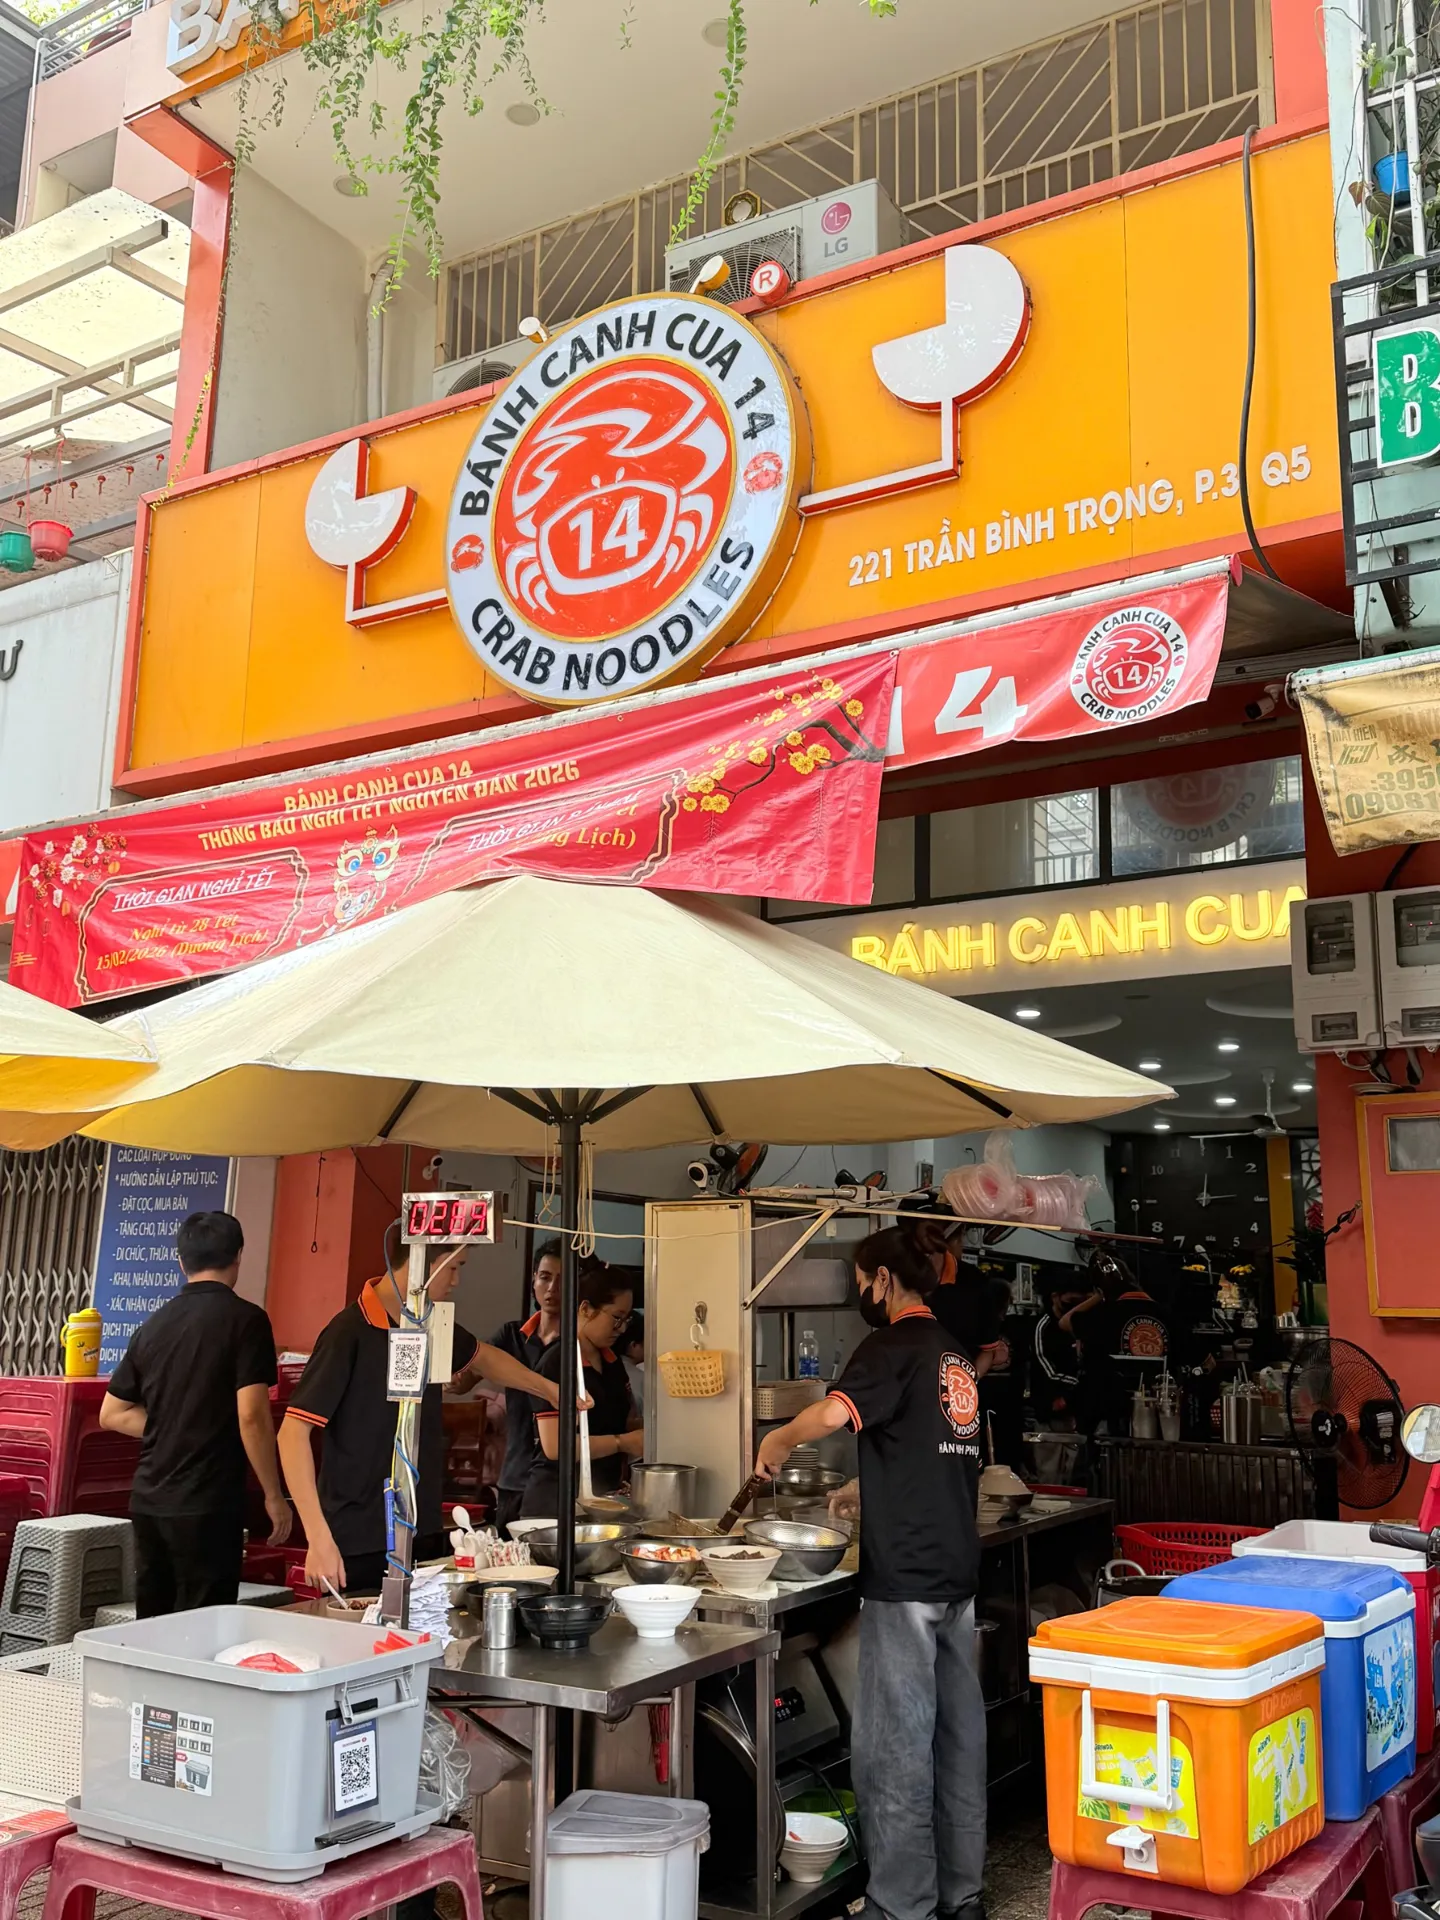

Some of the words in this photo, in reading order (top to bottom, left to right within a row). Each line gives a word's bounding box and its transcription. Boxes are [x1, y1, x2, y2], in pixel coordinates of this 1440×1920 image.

[824, 237, 849, 258] LG
[459, 386, 540, 517] BÁNH
[540, 310, 657, 388] CANH
[665, 313, 743, 381] CUA
[734, 376, 775, 441] 14
[849, 548, 892, 586] 221
[903, 517, 976, 574] TRẦN
[985, 509, 1055, 555] BÌNH
[1063, 478, 1184, 535] TRỌNG,
[1261, 445, 1312, 487] Q5
[568, 496, 645, 572] 14
[471, 598, 556, 685] CRAB
[562, 537, 754, 691] NOODLES
[1102, 610, 1142, 632] CANH
[1144, 611, 1172, 634] CUA
[1170, 633, 1184, 653] 14
[1113, 665, 1142, 687] 14
[1080, 692, 1114, 719] CRAB
[1115, 678, 1176, 721] NOODLES
[284, 787, 338, 813] BÁNH
[343, 775, 398, 803] CANH
[403, 766, 445, 789] CUA
[449, 760, 473, 781] 14
[198, 824, 257, 851] THÔNG
[523, 760, 581, 790] 2026
[575, 827, 637, 849] Lịch)
[155, 882, 196, 904] GIAN
[199, 870, 243, 895] NGHỈ
[190, 918, 208, 933] 28
[850, 921, 995, 974] BÁNH
[1008, 902, 1171, 963] CANH
[1185, 886, 1307, 945] CUA
[96, 943, 169, 971] 15/02/2026
[154, 1198, 172, 1210] MUA
[173, 1194, 188, 1210] BÁN
[409, 1201, 487, 1235] 0289
[155, 1273, 163, 1287] DI
[961, 1362, 976, 1379] CUA
